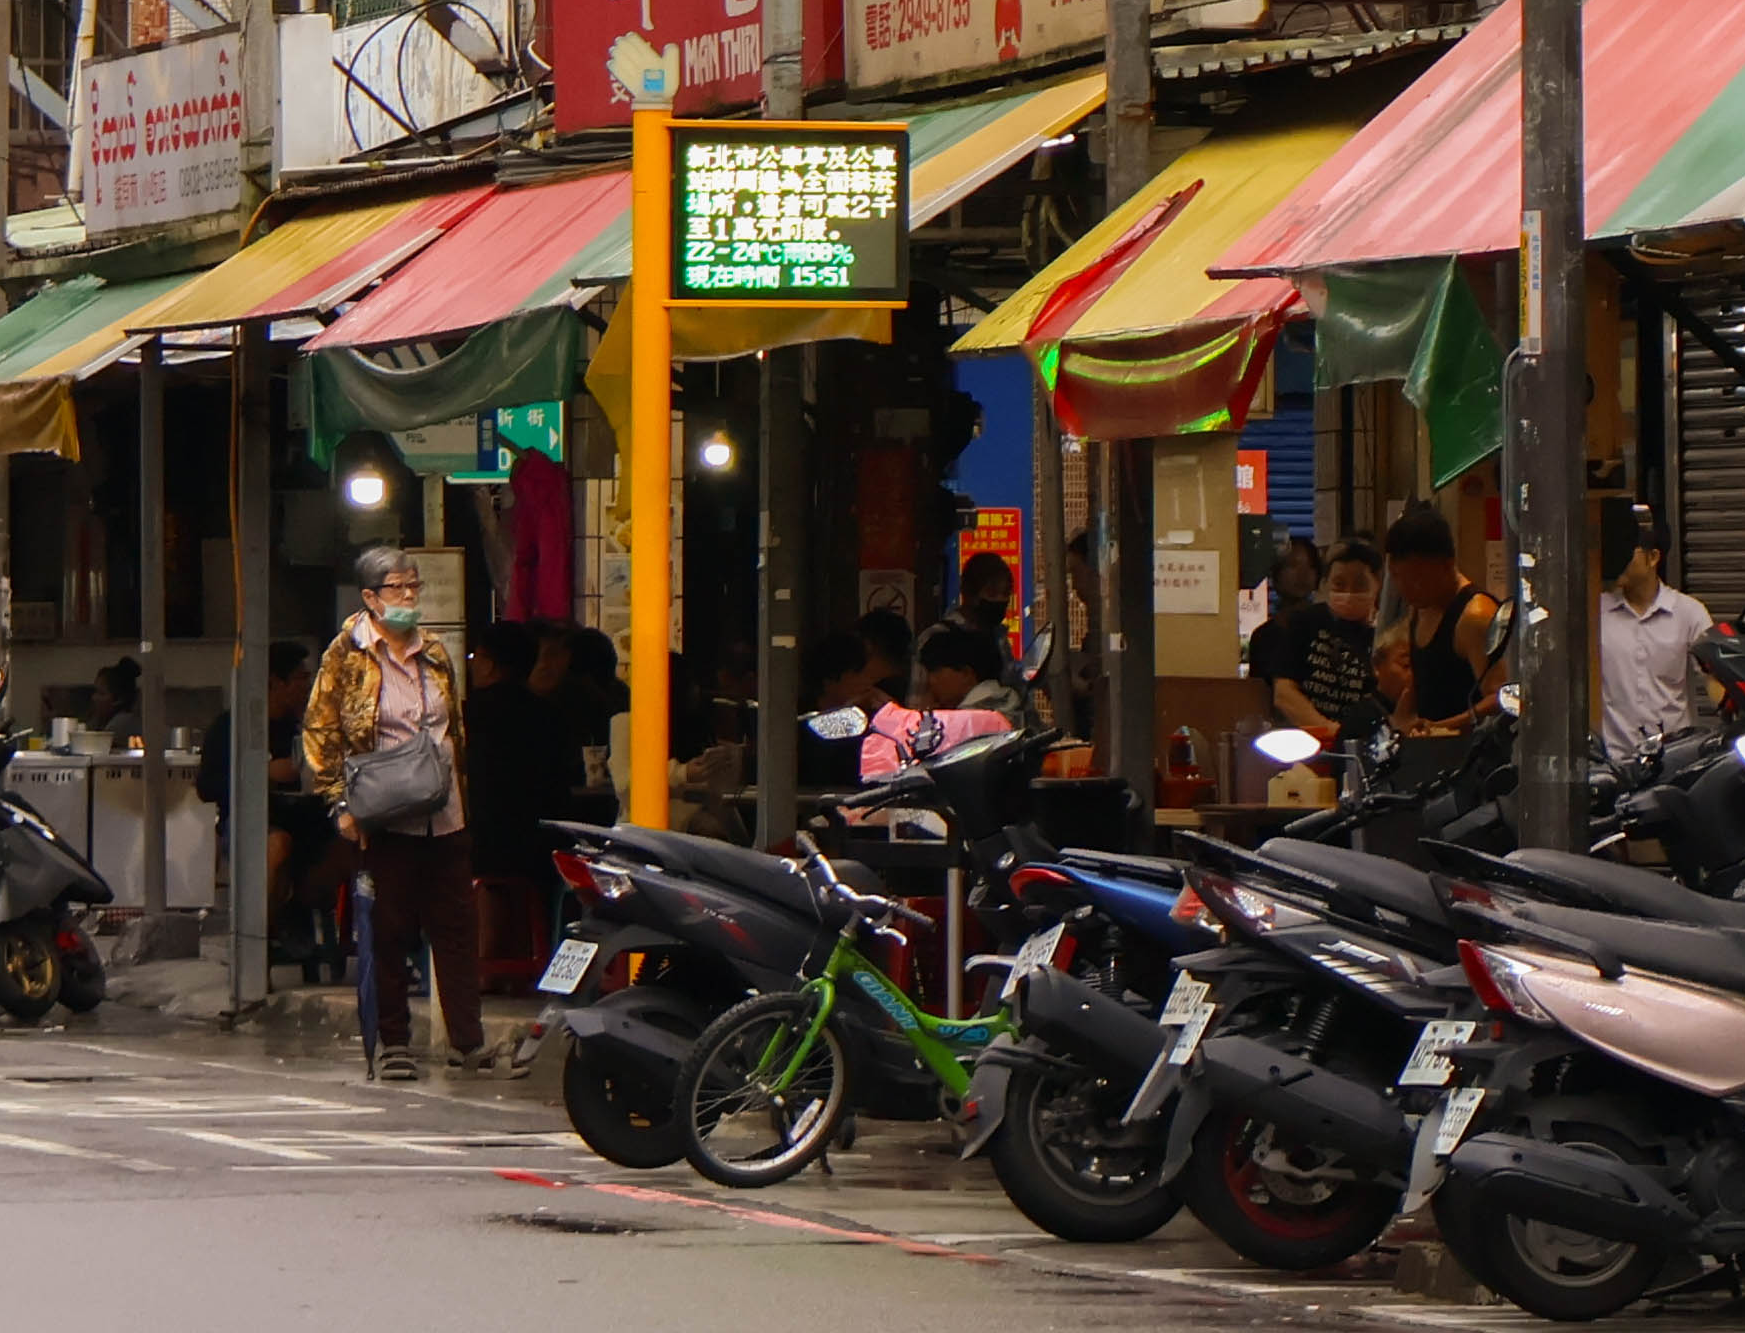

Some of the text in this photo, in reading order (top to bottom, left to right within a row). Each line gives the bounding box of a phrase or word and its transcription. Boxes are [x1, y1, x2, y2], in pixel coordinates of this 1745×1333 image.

[685, 265, 851, 289] 現在時間 15:51
[853, 970, 919, 1030] GIANT
